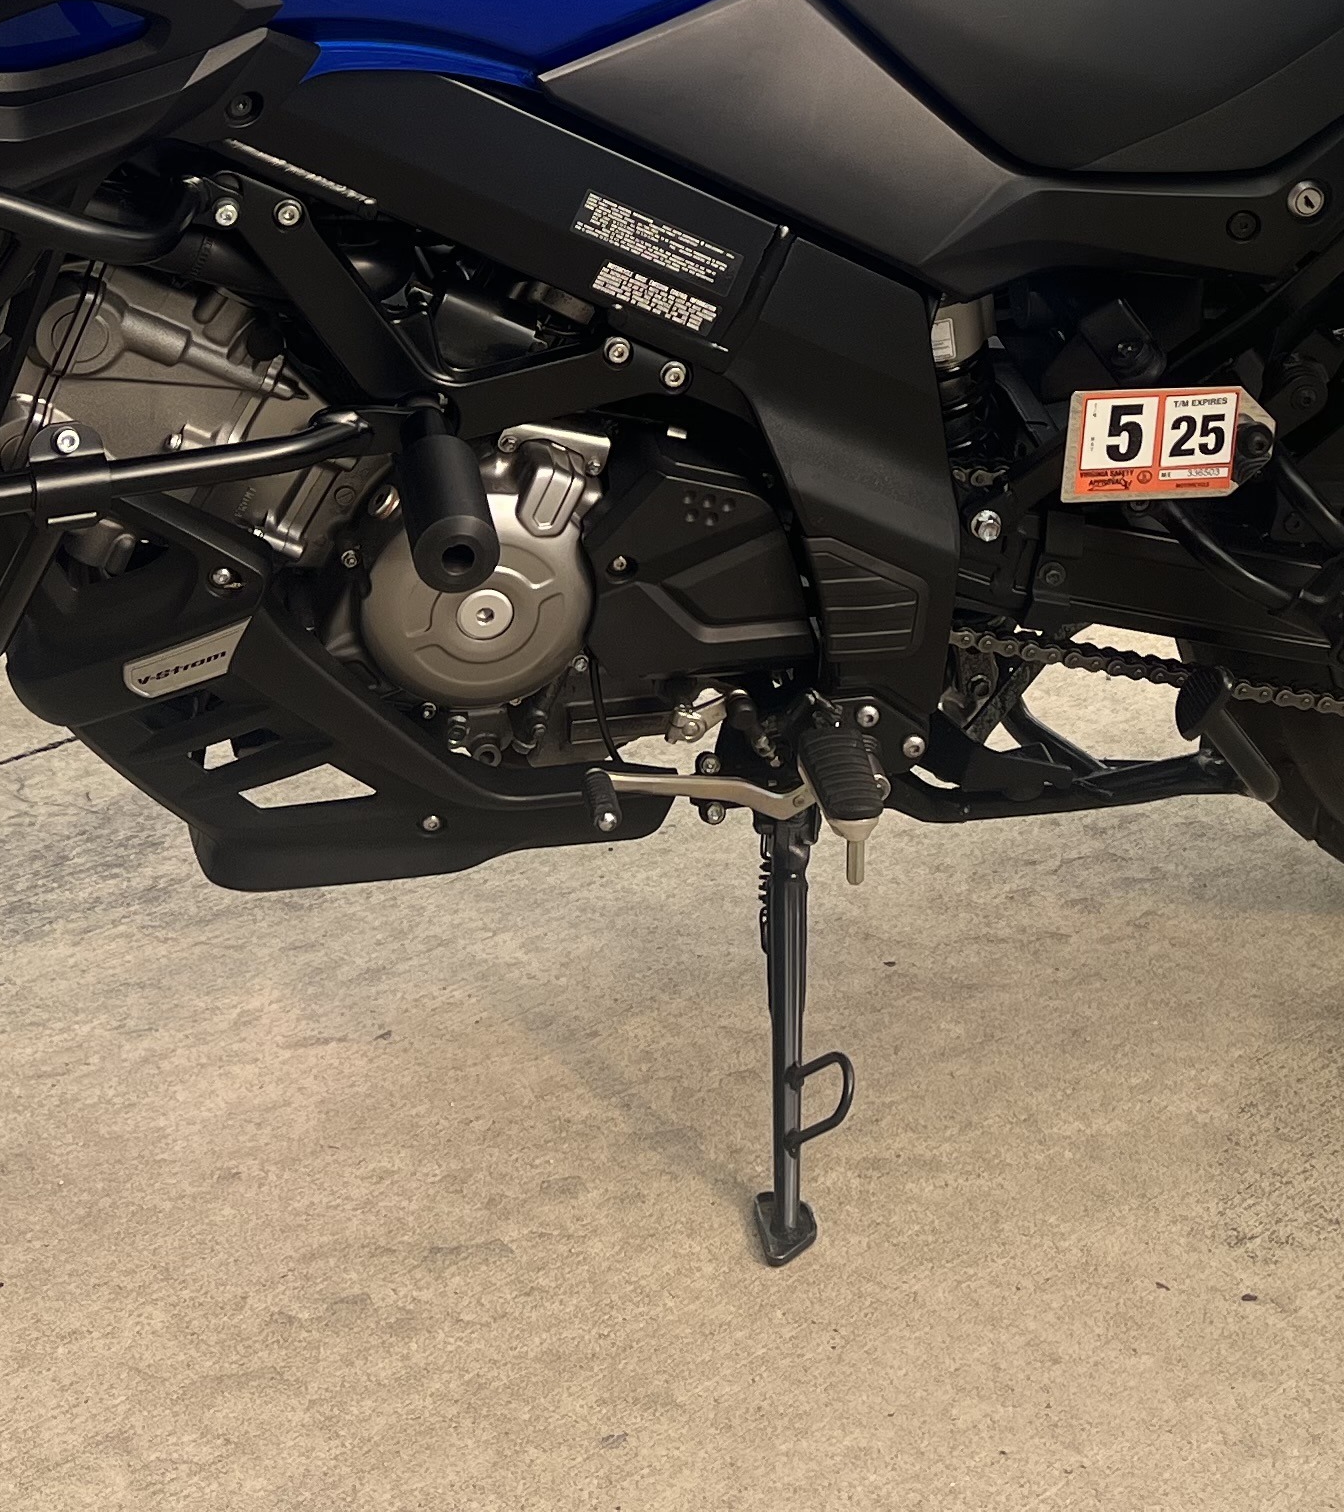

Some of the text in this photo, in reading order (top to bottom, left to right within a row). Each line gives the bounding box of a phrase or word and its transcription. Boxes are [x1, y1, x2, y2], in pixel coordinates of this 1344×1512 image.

[1191, 397, 1228, 407] EXPIRES
[1106, 403, 1144, 462] 5
[1168, 413, 1226, 458] 25
